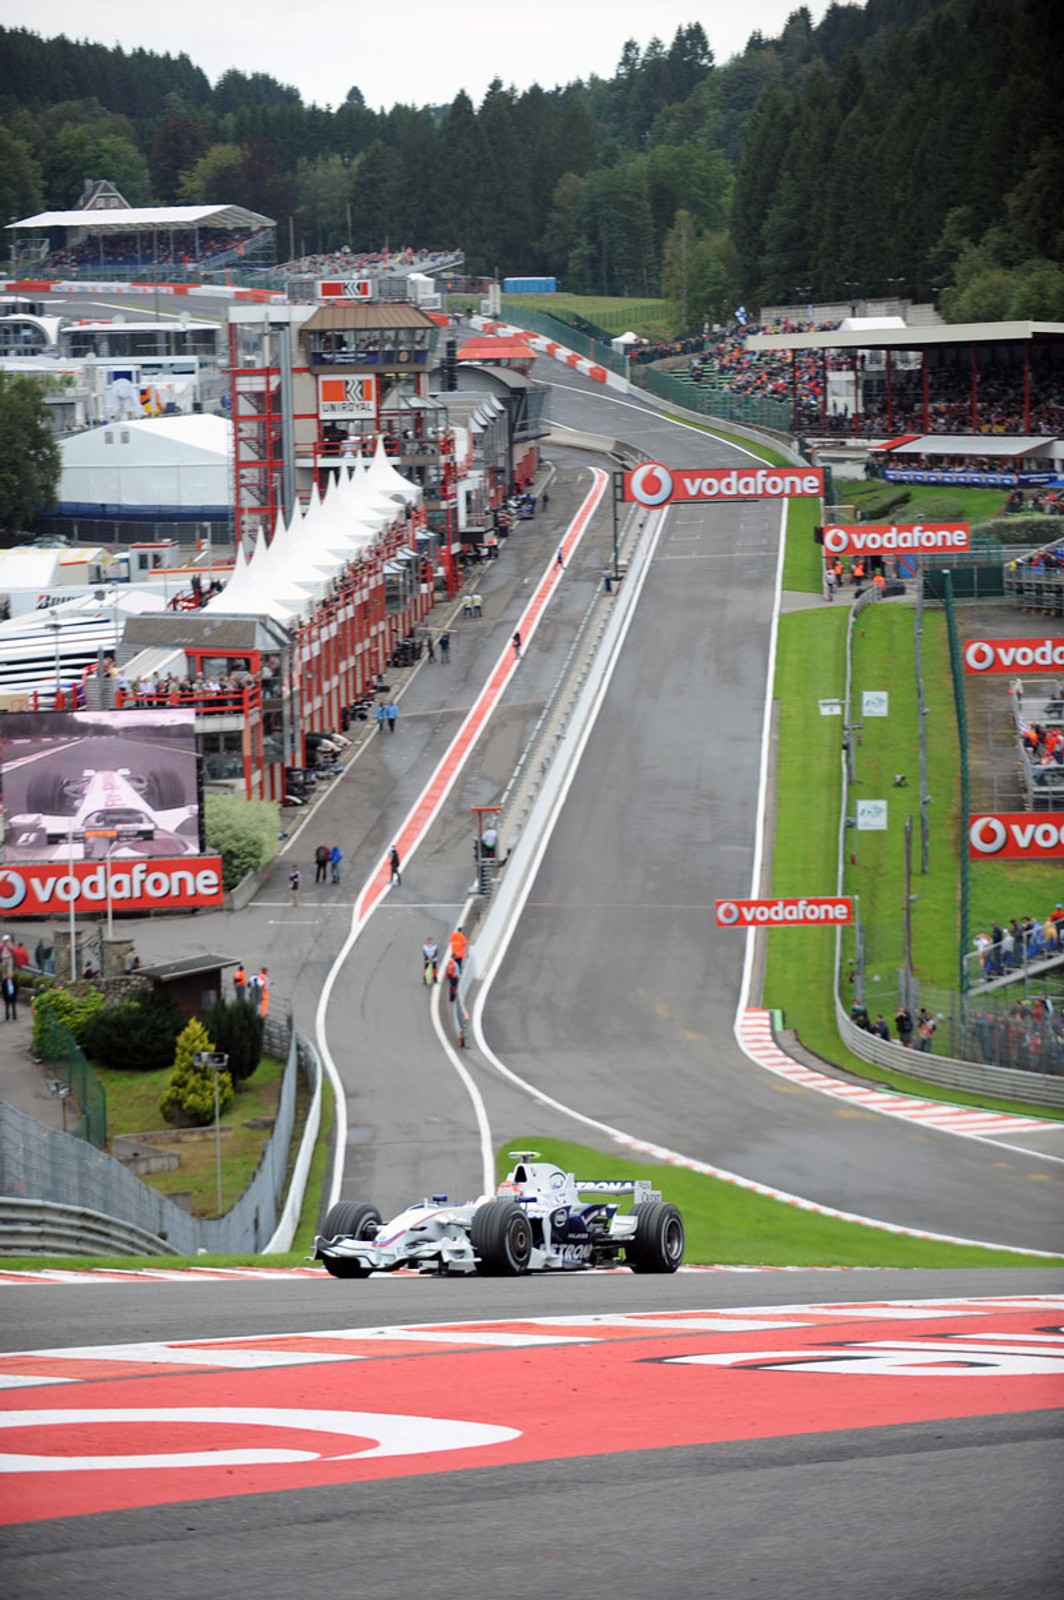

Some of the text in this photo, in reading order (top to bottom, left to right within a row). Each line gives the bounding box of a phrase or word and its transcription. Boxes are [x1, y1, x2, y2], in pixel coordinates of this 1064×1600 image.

[321, 402, 373, 412] UNIROYAL
[683, 470, 820, 497] vodafone
[850, 526, 967, 549] vodafone
[1010, 823, 1064, 849] vo
[30, 863, 219, 902] vodafone
[740, 899, 848, 921] vodafone
